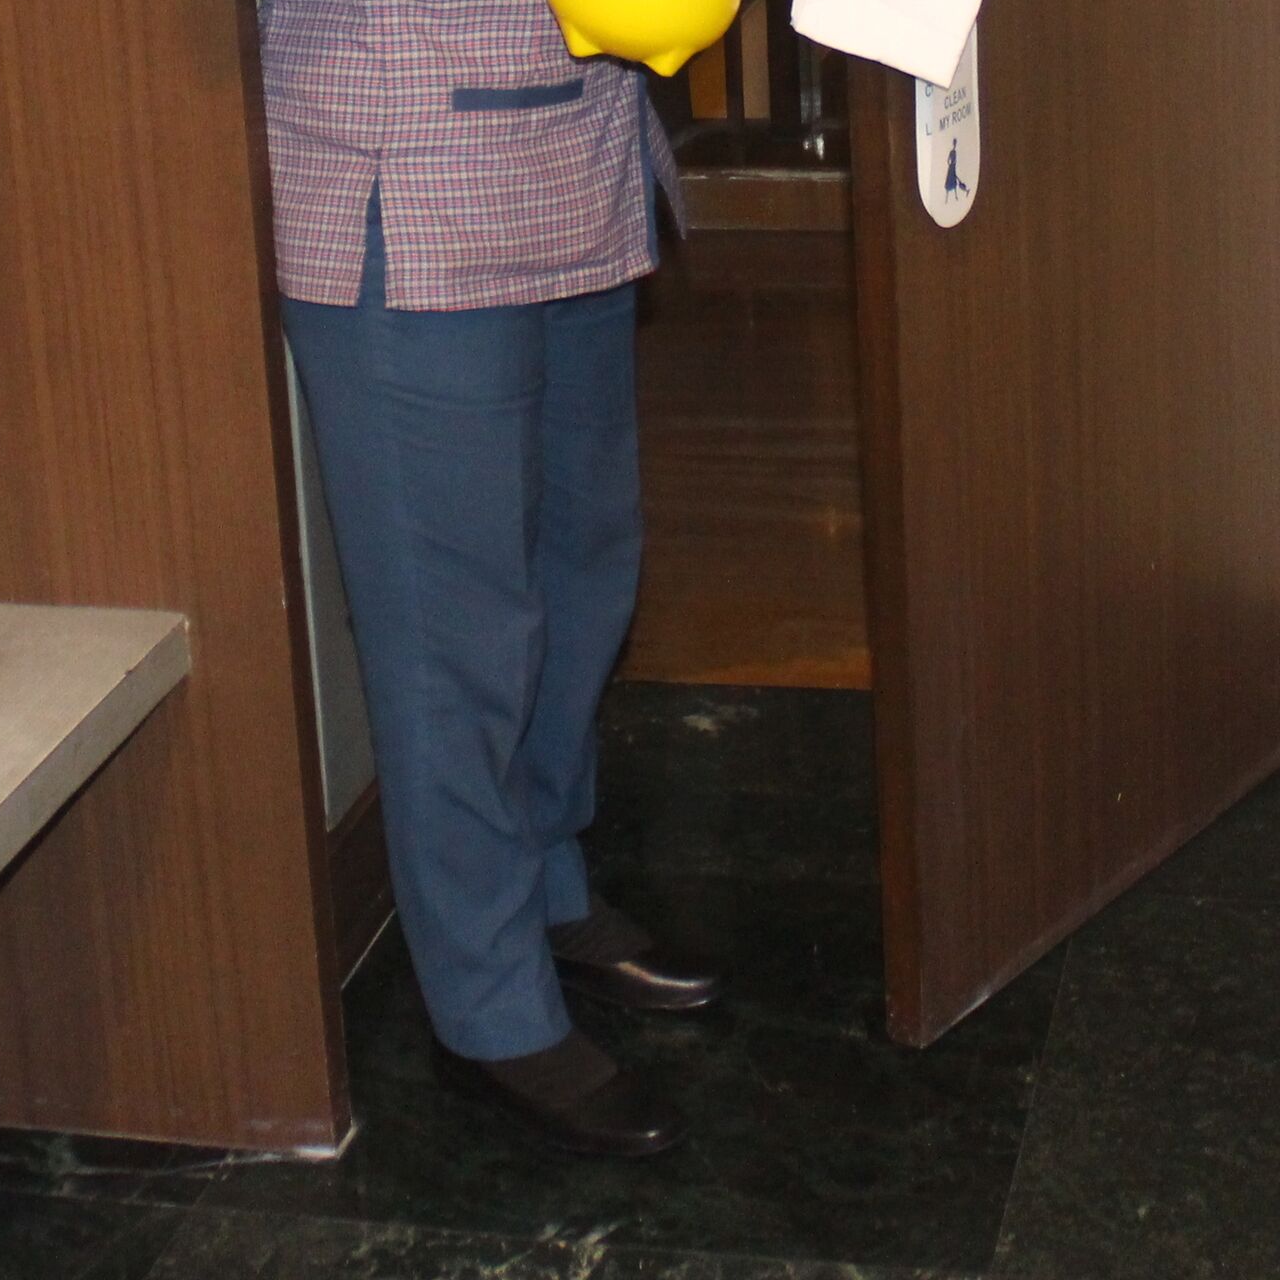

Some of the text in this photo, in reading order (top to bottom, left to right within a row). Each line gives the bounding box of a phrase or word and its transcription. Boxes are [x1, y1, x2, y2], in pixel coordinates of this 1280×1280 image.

[944, 86, 967, 109] CLEAN
[939, 103, 971, 131] MY ROOM
